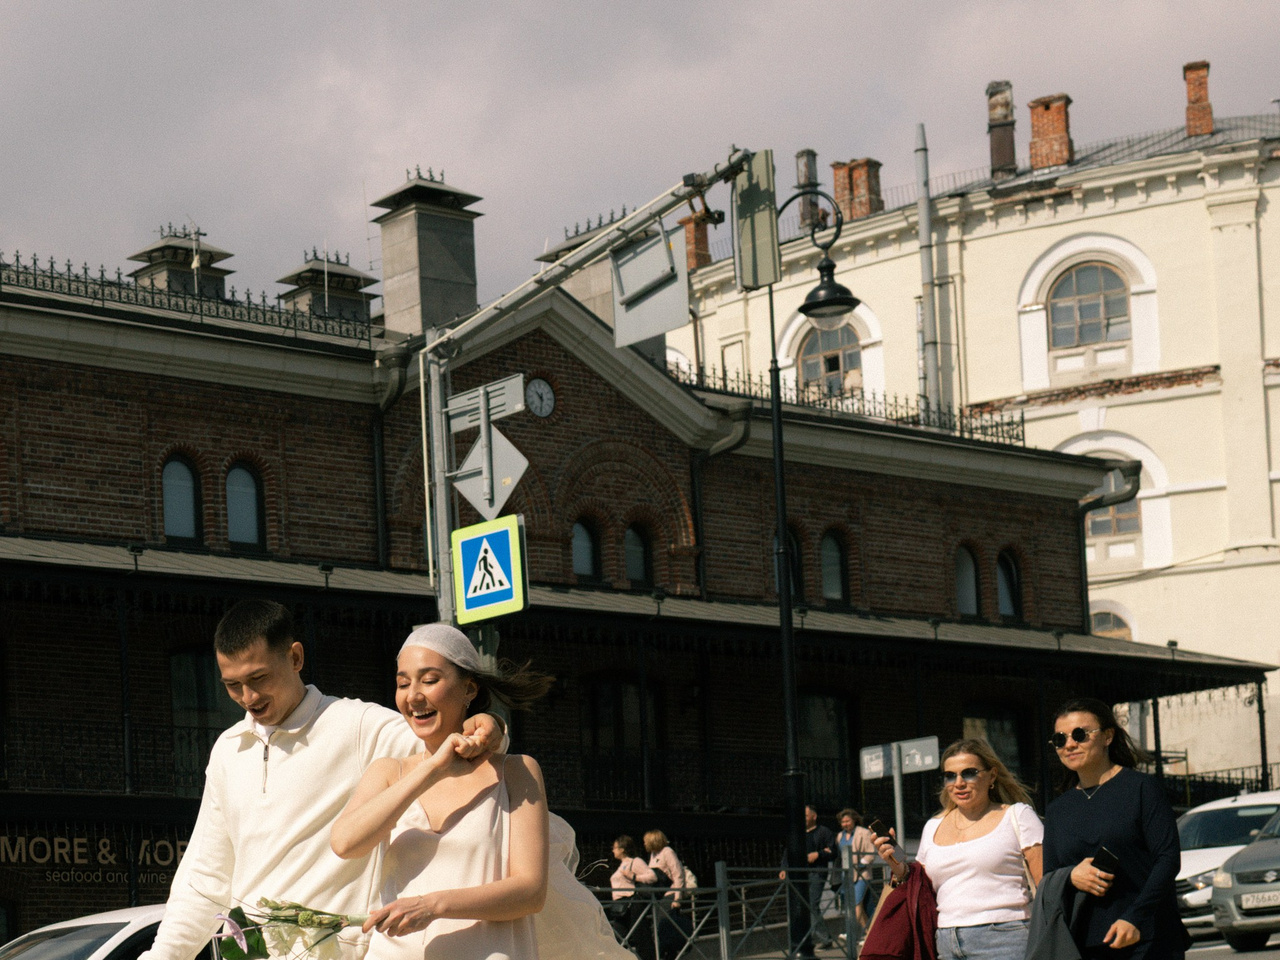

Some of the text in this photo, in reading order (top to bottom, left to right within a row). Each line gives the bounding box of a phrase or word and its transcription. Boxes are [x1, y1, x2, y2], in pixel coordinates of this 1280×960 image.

[0, 836, 88, 864] MORE
[97, 838, 117, 865] &
[46, 867, 101, 883] seafood
[138, 868, 167, 884] wine
